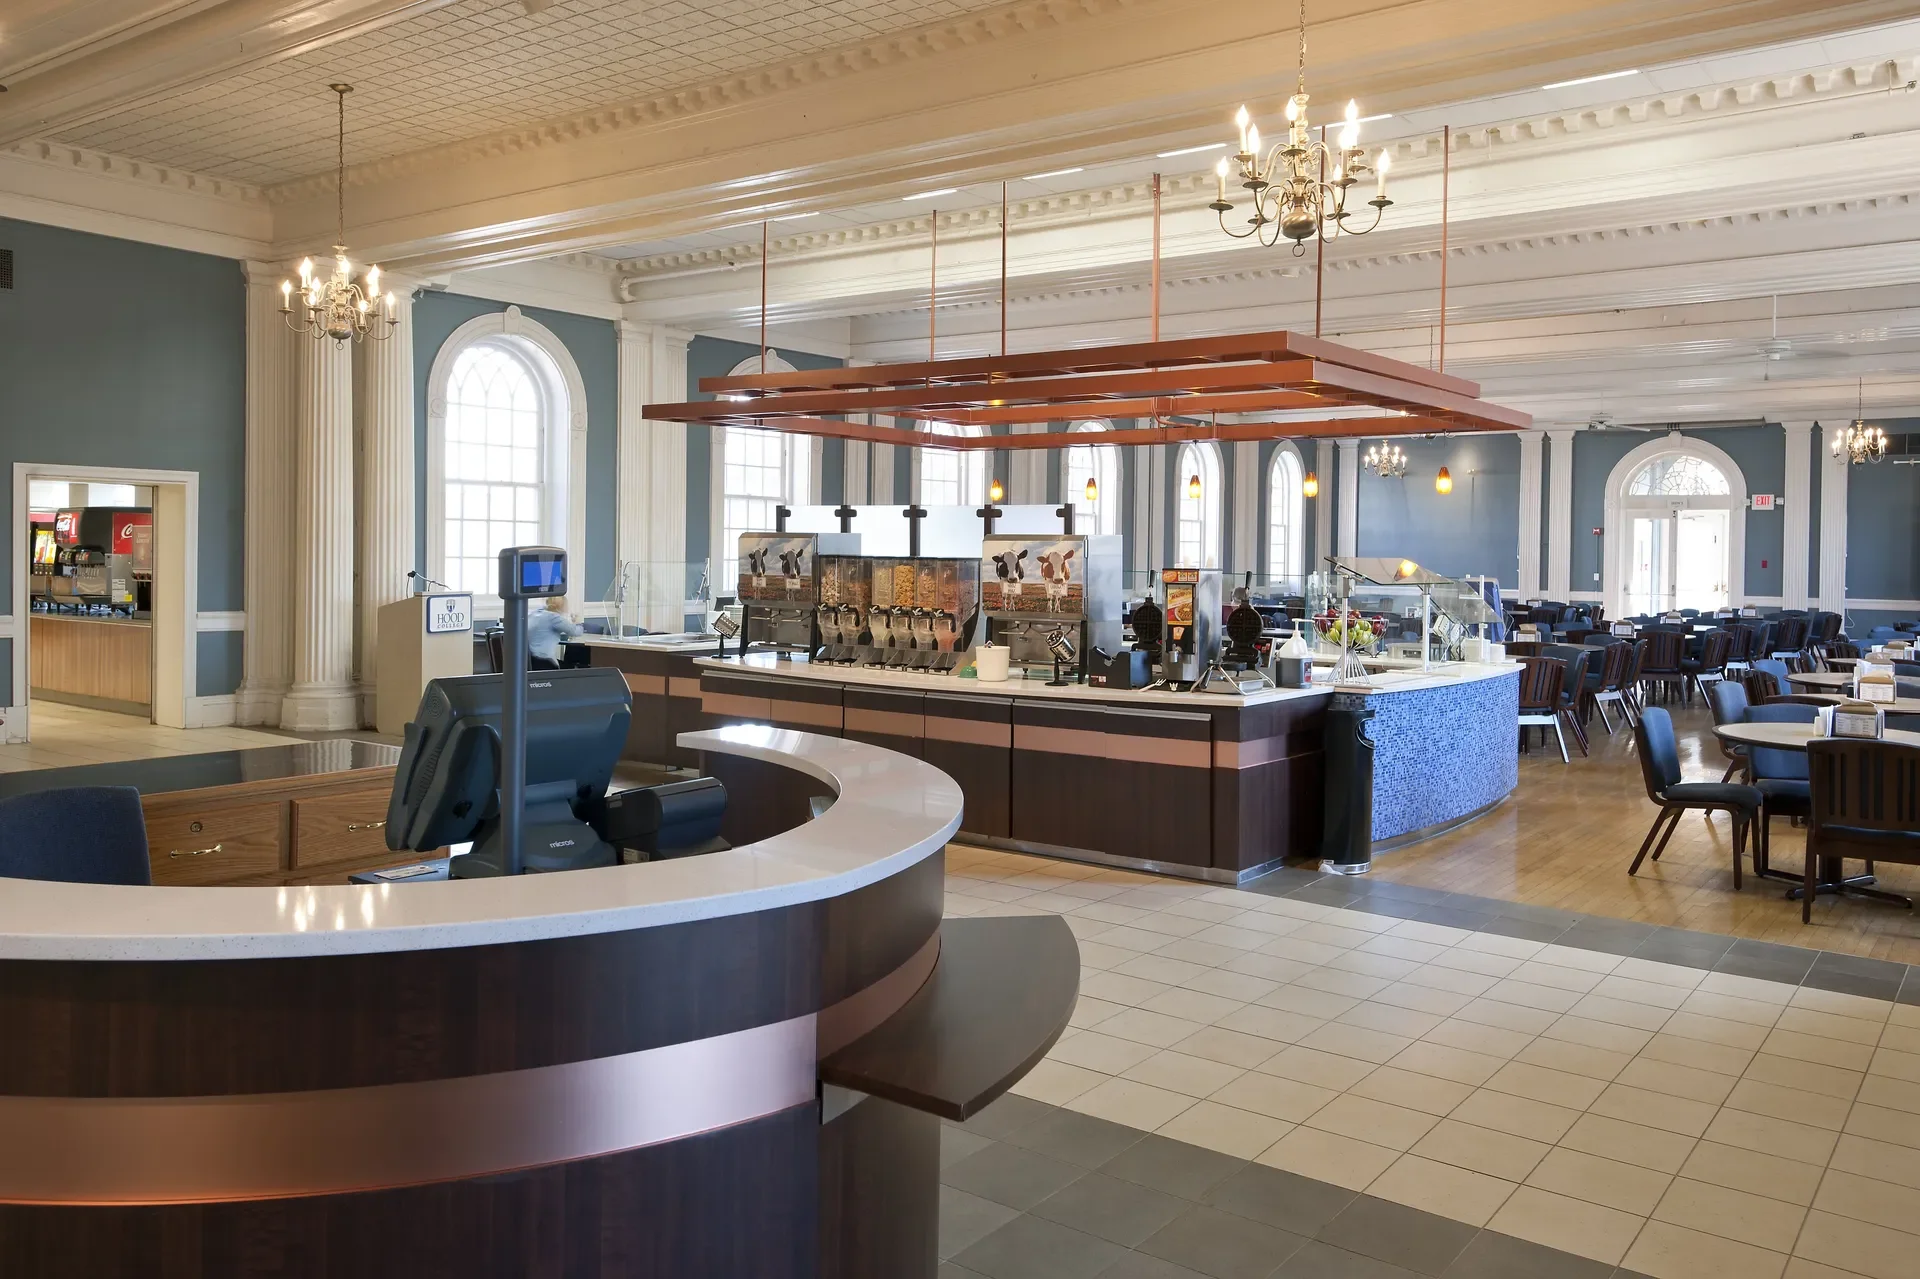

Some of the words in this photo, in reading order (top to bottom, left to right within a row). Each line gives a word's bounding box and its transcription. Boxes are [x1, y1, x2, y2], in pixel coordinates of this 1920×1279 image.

[1755, 495, 1770, 506] EXIT
[437, 612, 465, 624] HOOD
[549, 839, 575, 848] micros
